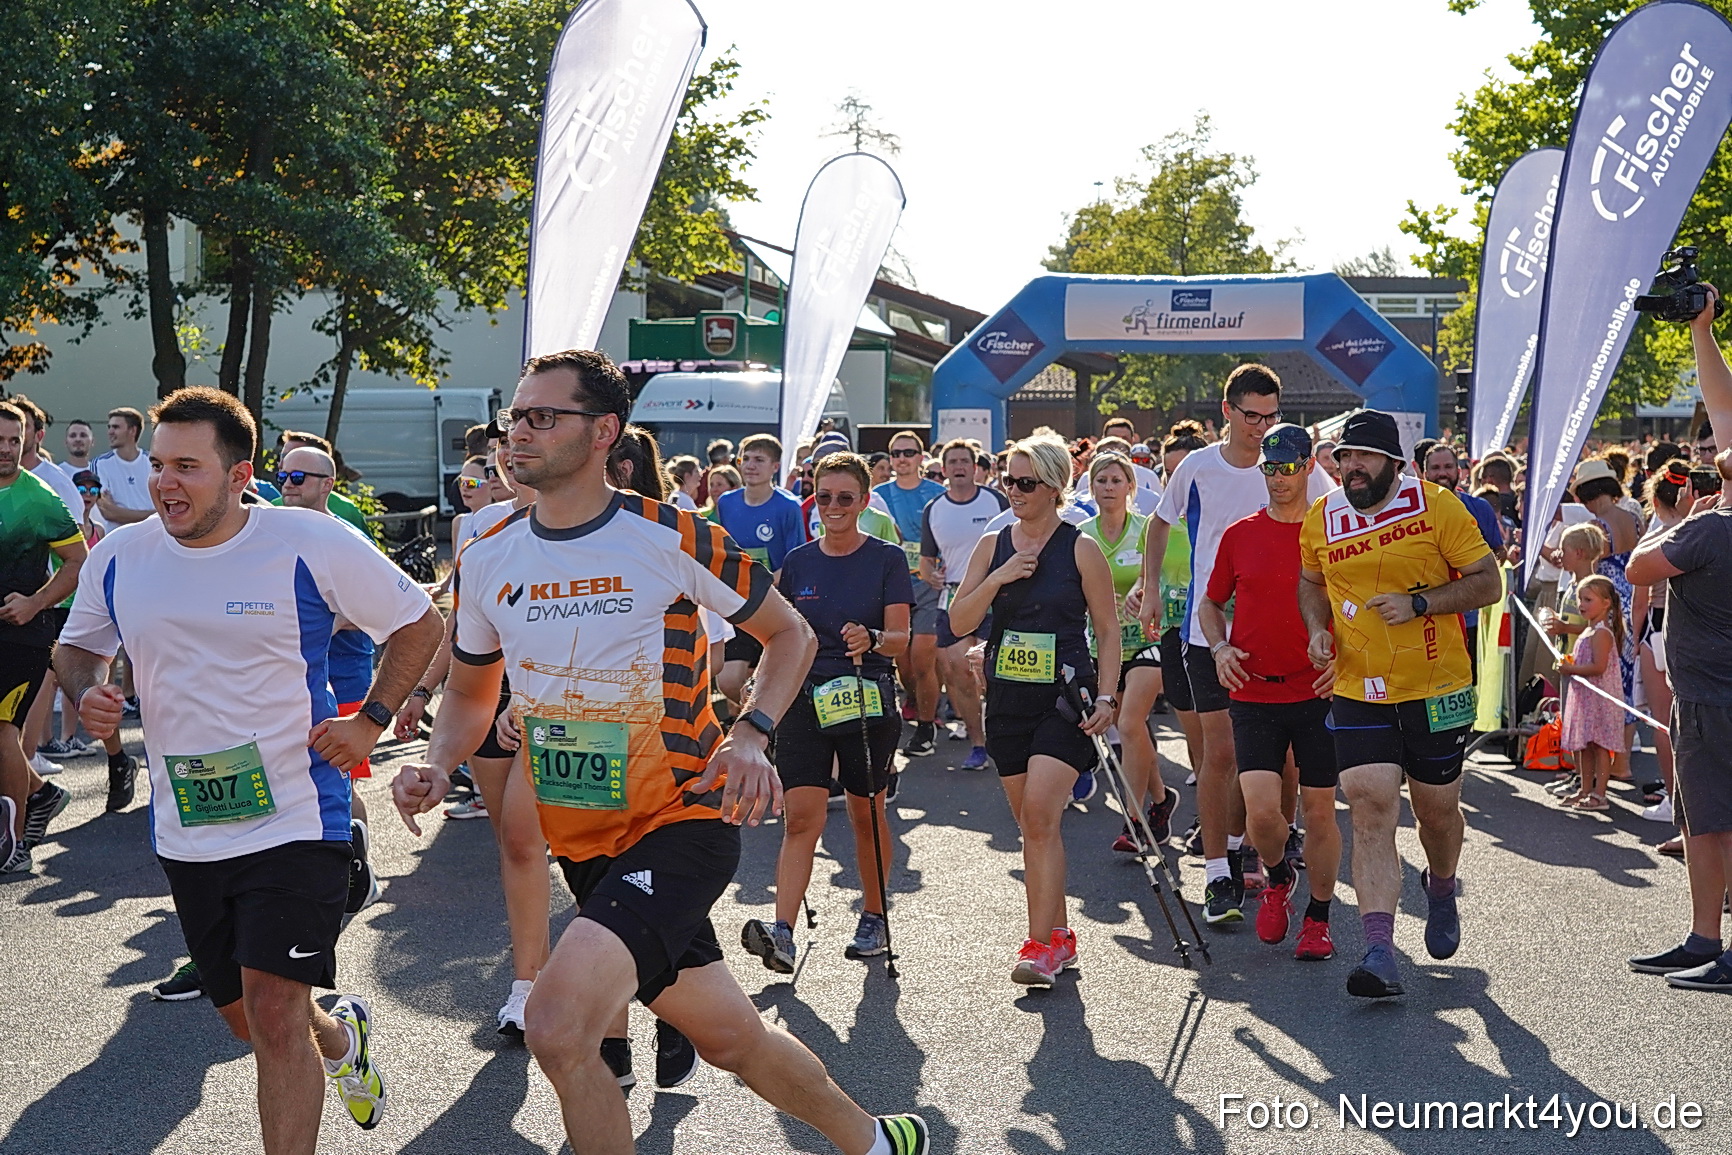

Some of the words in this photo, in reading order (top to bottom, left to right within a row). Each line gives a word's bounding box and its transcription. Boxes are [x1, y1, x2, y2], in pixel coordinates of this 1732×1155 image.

[587, 14, 660, 163] Fischer
[621, 34, 672, 154] AUTOMOBILE
[1614, 42, 1699, 193] Fischer
[1651, 65, 1714, 187] AUTOMOBILE
[824, 180, 876, 278] Fischer
[1515, 174, 1559, 278] Fischer
[575, 244, 619, 350] utomobile.de
[1157, 311, 1245, 329] firmenlauf
[986, 339, 1034, 351] Fischer
[1546, 277, 1641, 490] www.fischer-automobile.de
[1328, 539, 1373, 565] MAX
[1378, 519, 1433, 547] BÖGL
[529, 576, 634, 601] KLEBL
[244, 602, 274, 610] PETTER
[526, 597, 634, 622] DYNAMICS
[1008, 649, 1038, 666] 489
[1044, 653, 1052, 676] 2022
[830, 690, 861, 707] 485
[1437, 690, 1472, 713] 1593
[1430, 704, 1439, 723] RUN
[532, 755, 541, 786] RUN
[540, 749, 607, 782] 1079
[610, 758, 621, 800] 2022
[177, 787, 192, 813] RUN
[193, 775, 239, 803] 307
[250, 772, 269, 807] 2022
[583, 782, 611, 792] Thomas
[195, 803, 226, 814] Gigliotti
[229, 799, 253, 810] Luca
[621, 874, 655, 896] adidas
